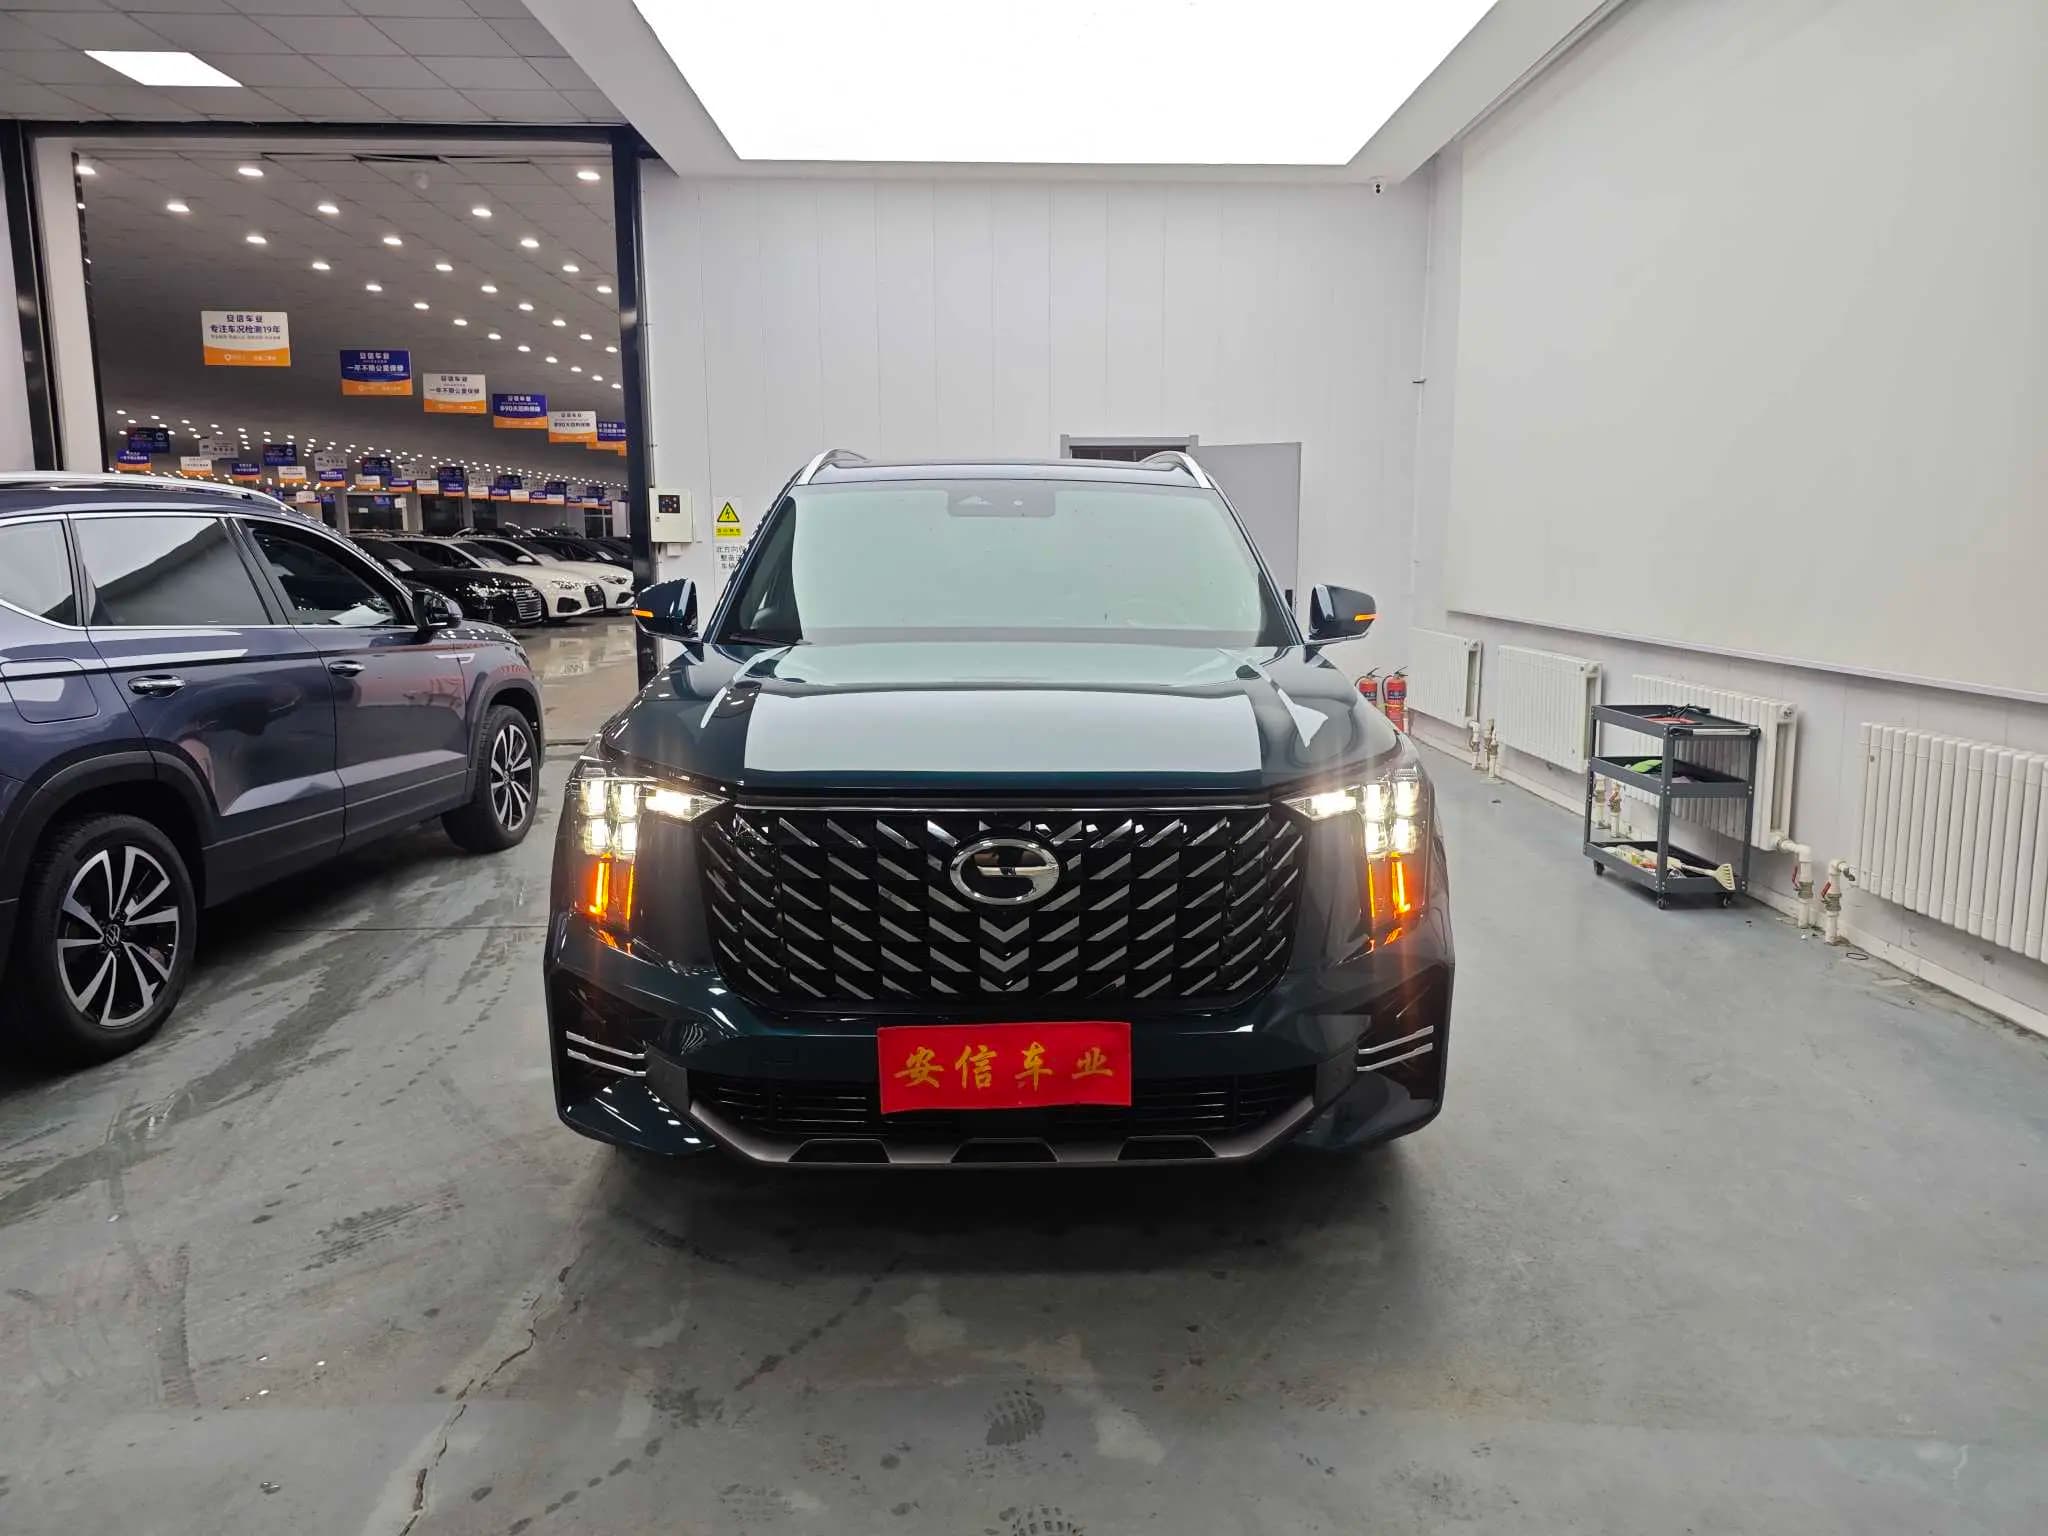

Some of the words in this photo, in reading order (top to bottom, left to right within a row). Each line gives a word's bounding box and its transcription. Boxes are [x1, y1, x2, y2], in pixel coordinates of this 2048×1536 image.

[209, 324, 281, 334] 专注车况检测19年
[895, 1041, 1113, 1091] 安信车业
